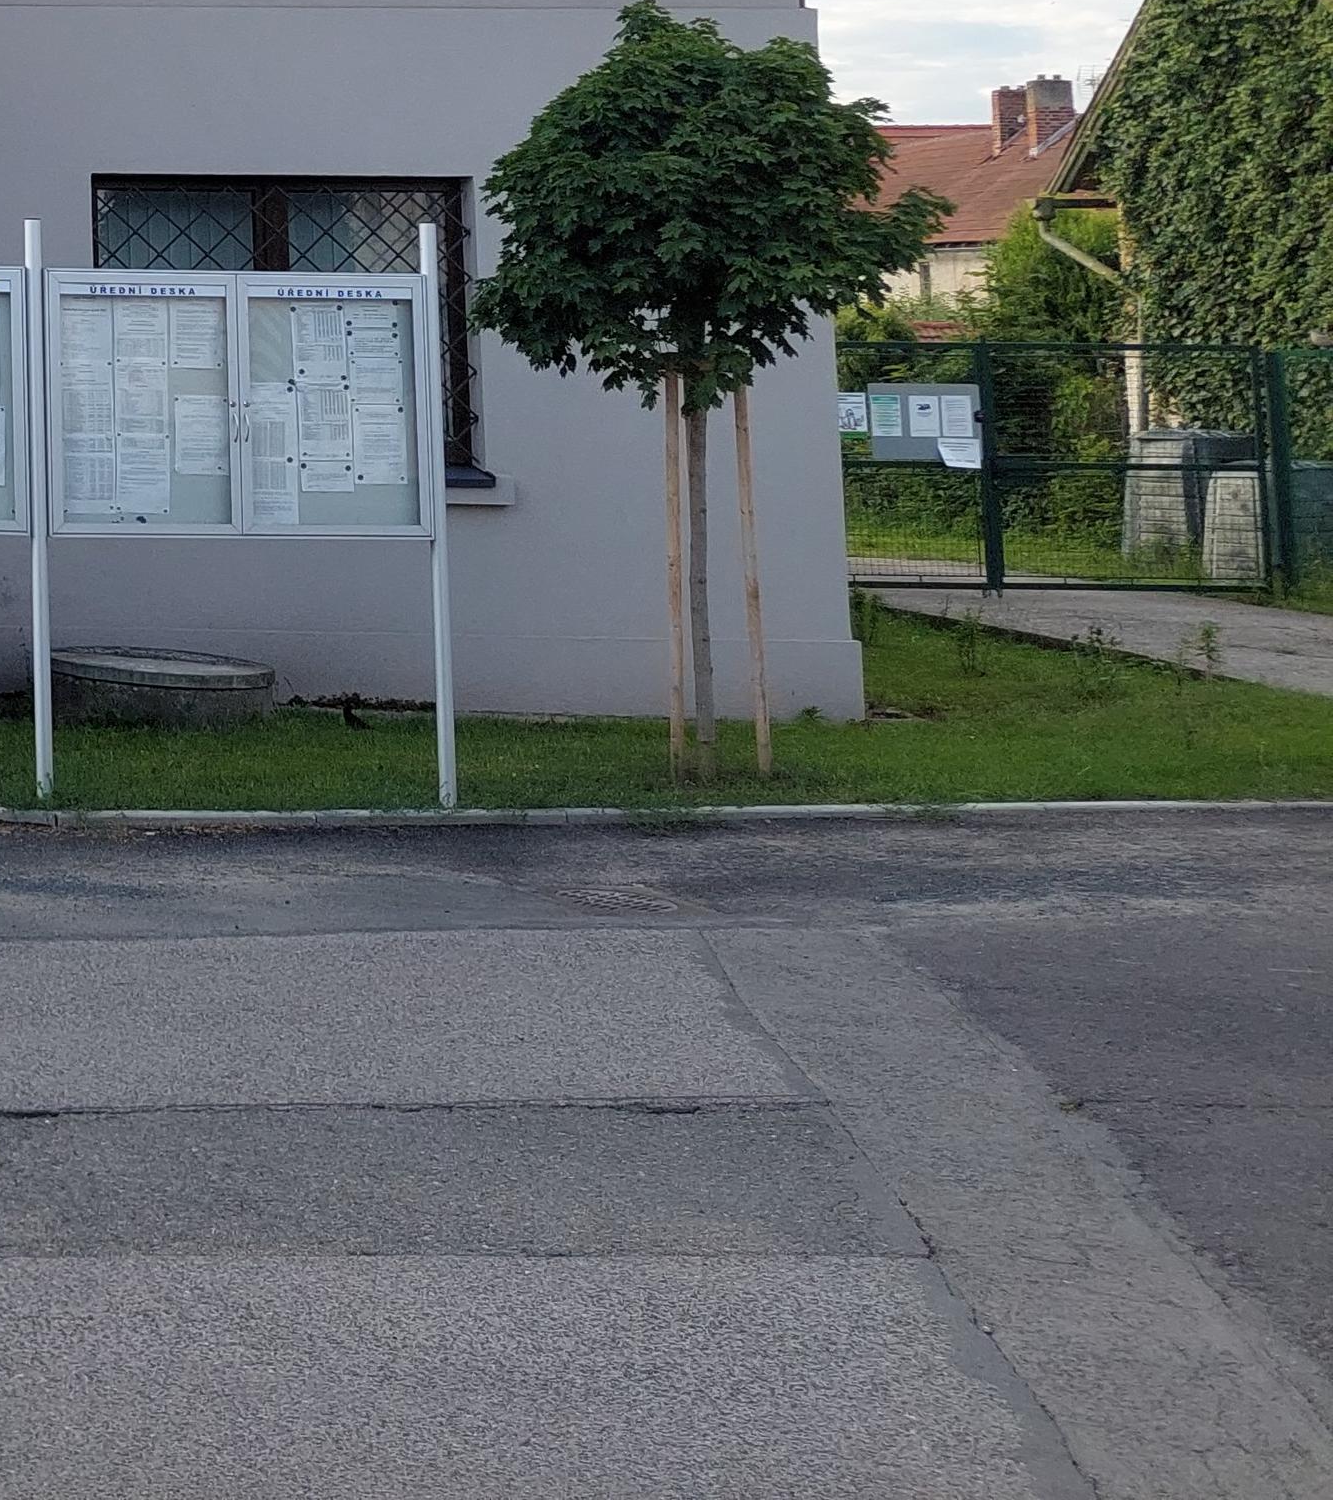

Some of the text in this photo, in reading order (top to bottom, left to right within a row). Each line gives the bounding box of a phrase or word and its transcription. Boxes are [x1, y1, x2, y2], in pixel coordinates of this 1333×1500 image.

[89, 284, 196, 296] ÚŘEDNÍ DESKA
[277, 287, 383, 298] ÚŘEDNÍ DESKA
